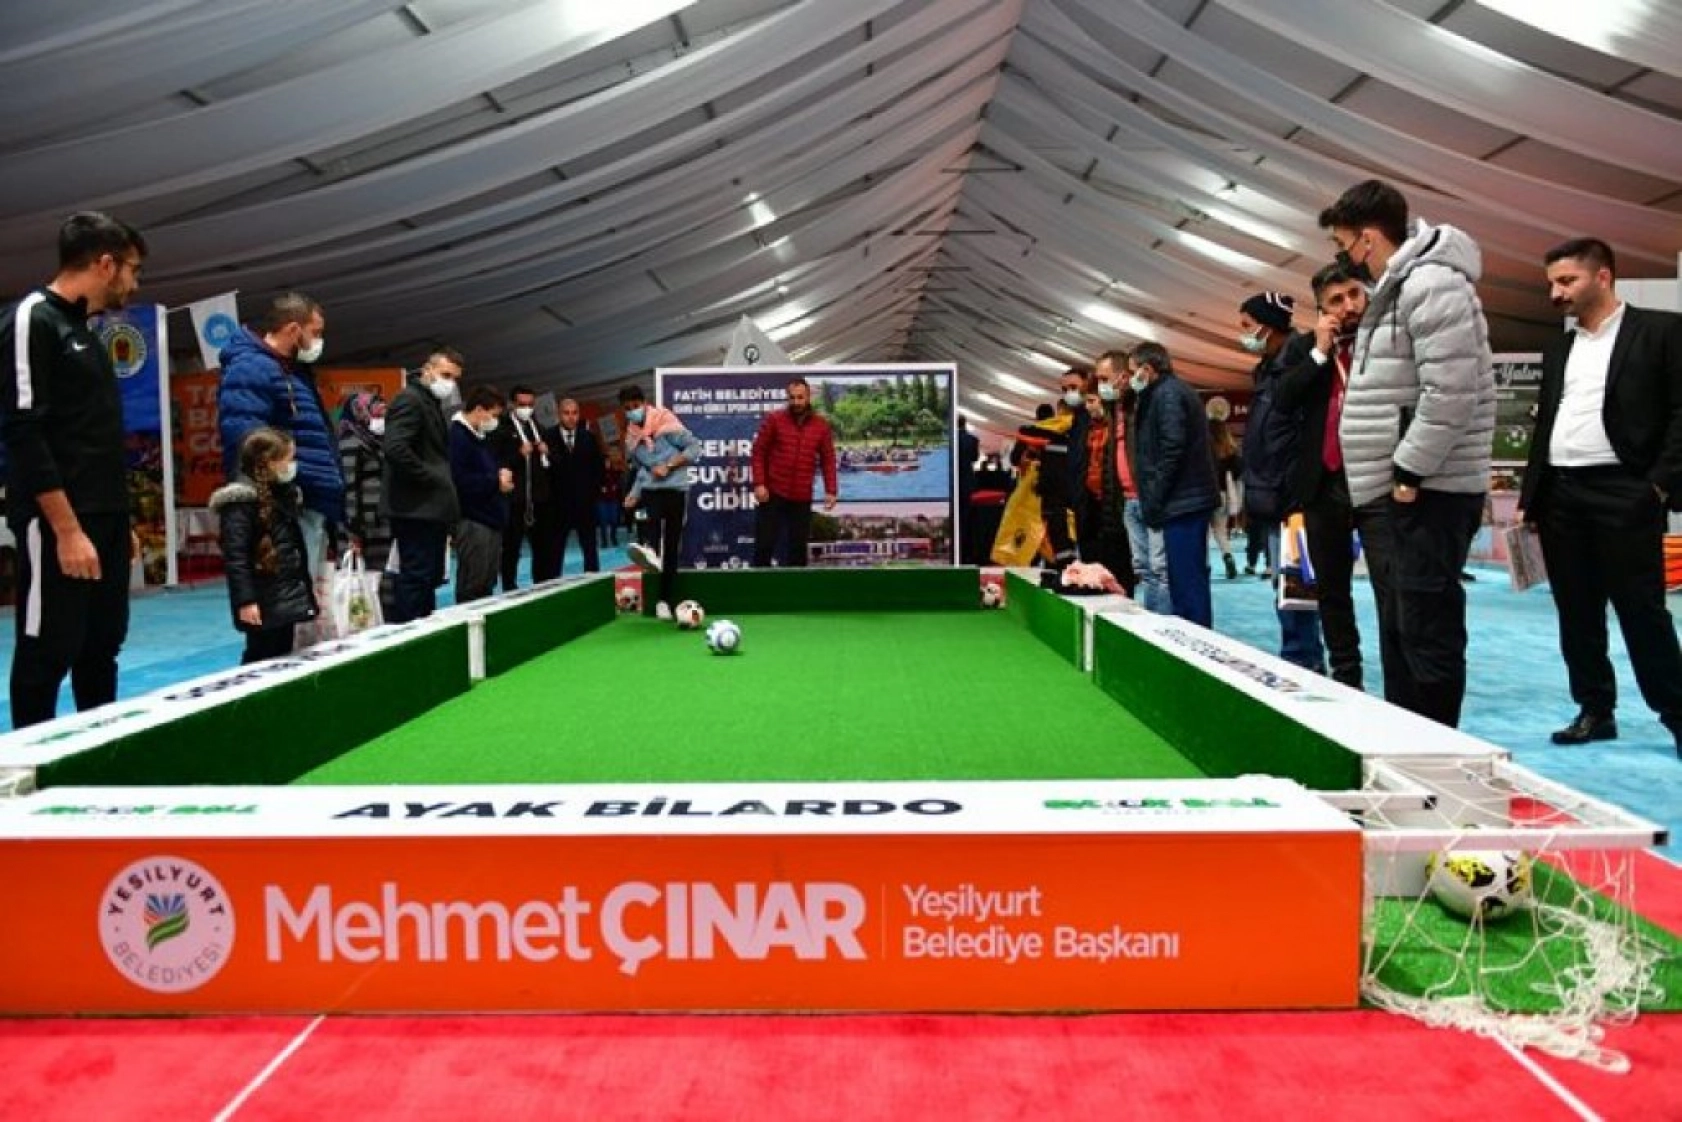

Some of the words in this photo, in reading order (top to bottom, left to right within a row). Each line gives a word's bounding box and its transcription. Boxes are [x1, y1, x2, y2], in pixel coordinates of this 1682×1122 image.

[673, 386, 712, 400] FATİH
[715, 386, 787, 400] BELEDİYES
[687, 466, 754, 484] SUYU
[330, 801, 564, 819] AYAK
[583, 797, 963, 816] BİLARDO
[902, 883, 1042, 922] Yeşilyurt
[263, 881, 592, 963] Mehmet
[600, 880, 868, 976] ÇINAR
[902, 925, 1042, 964] Belediye
[1054, 925, 1180, 963] Başkanı
